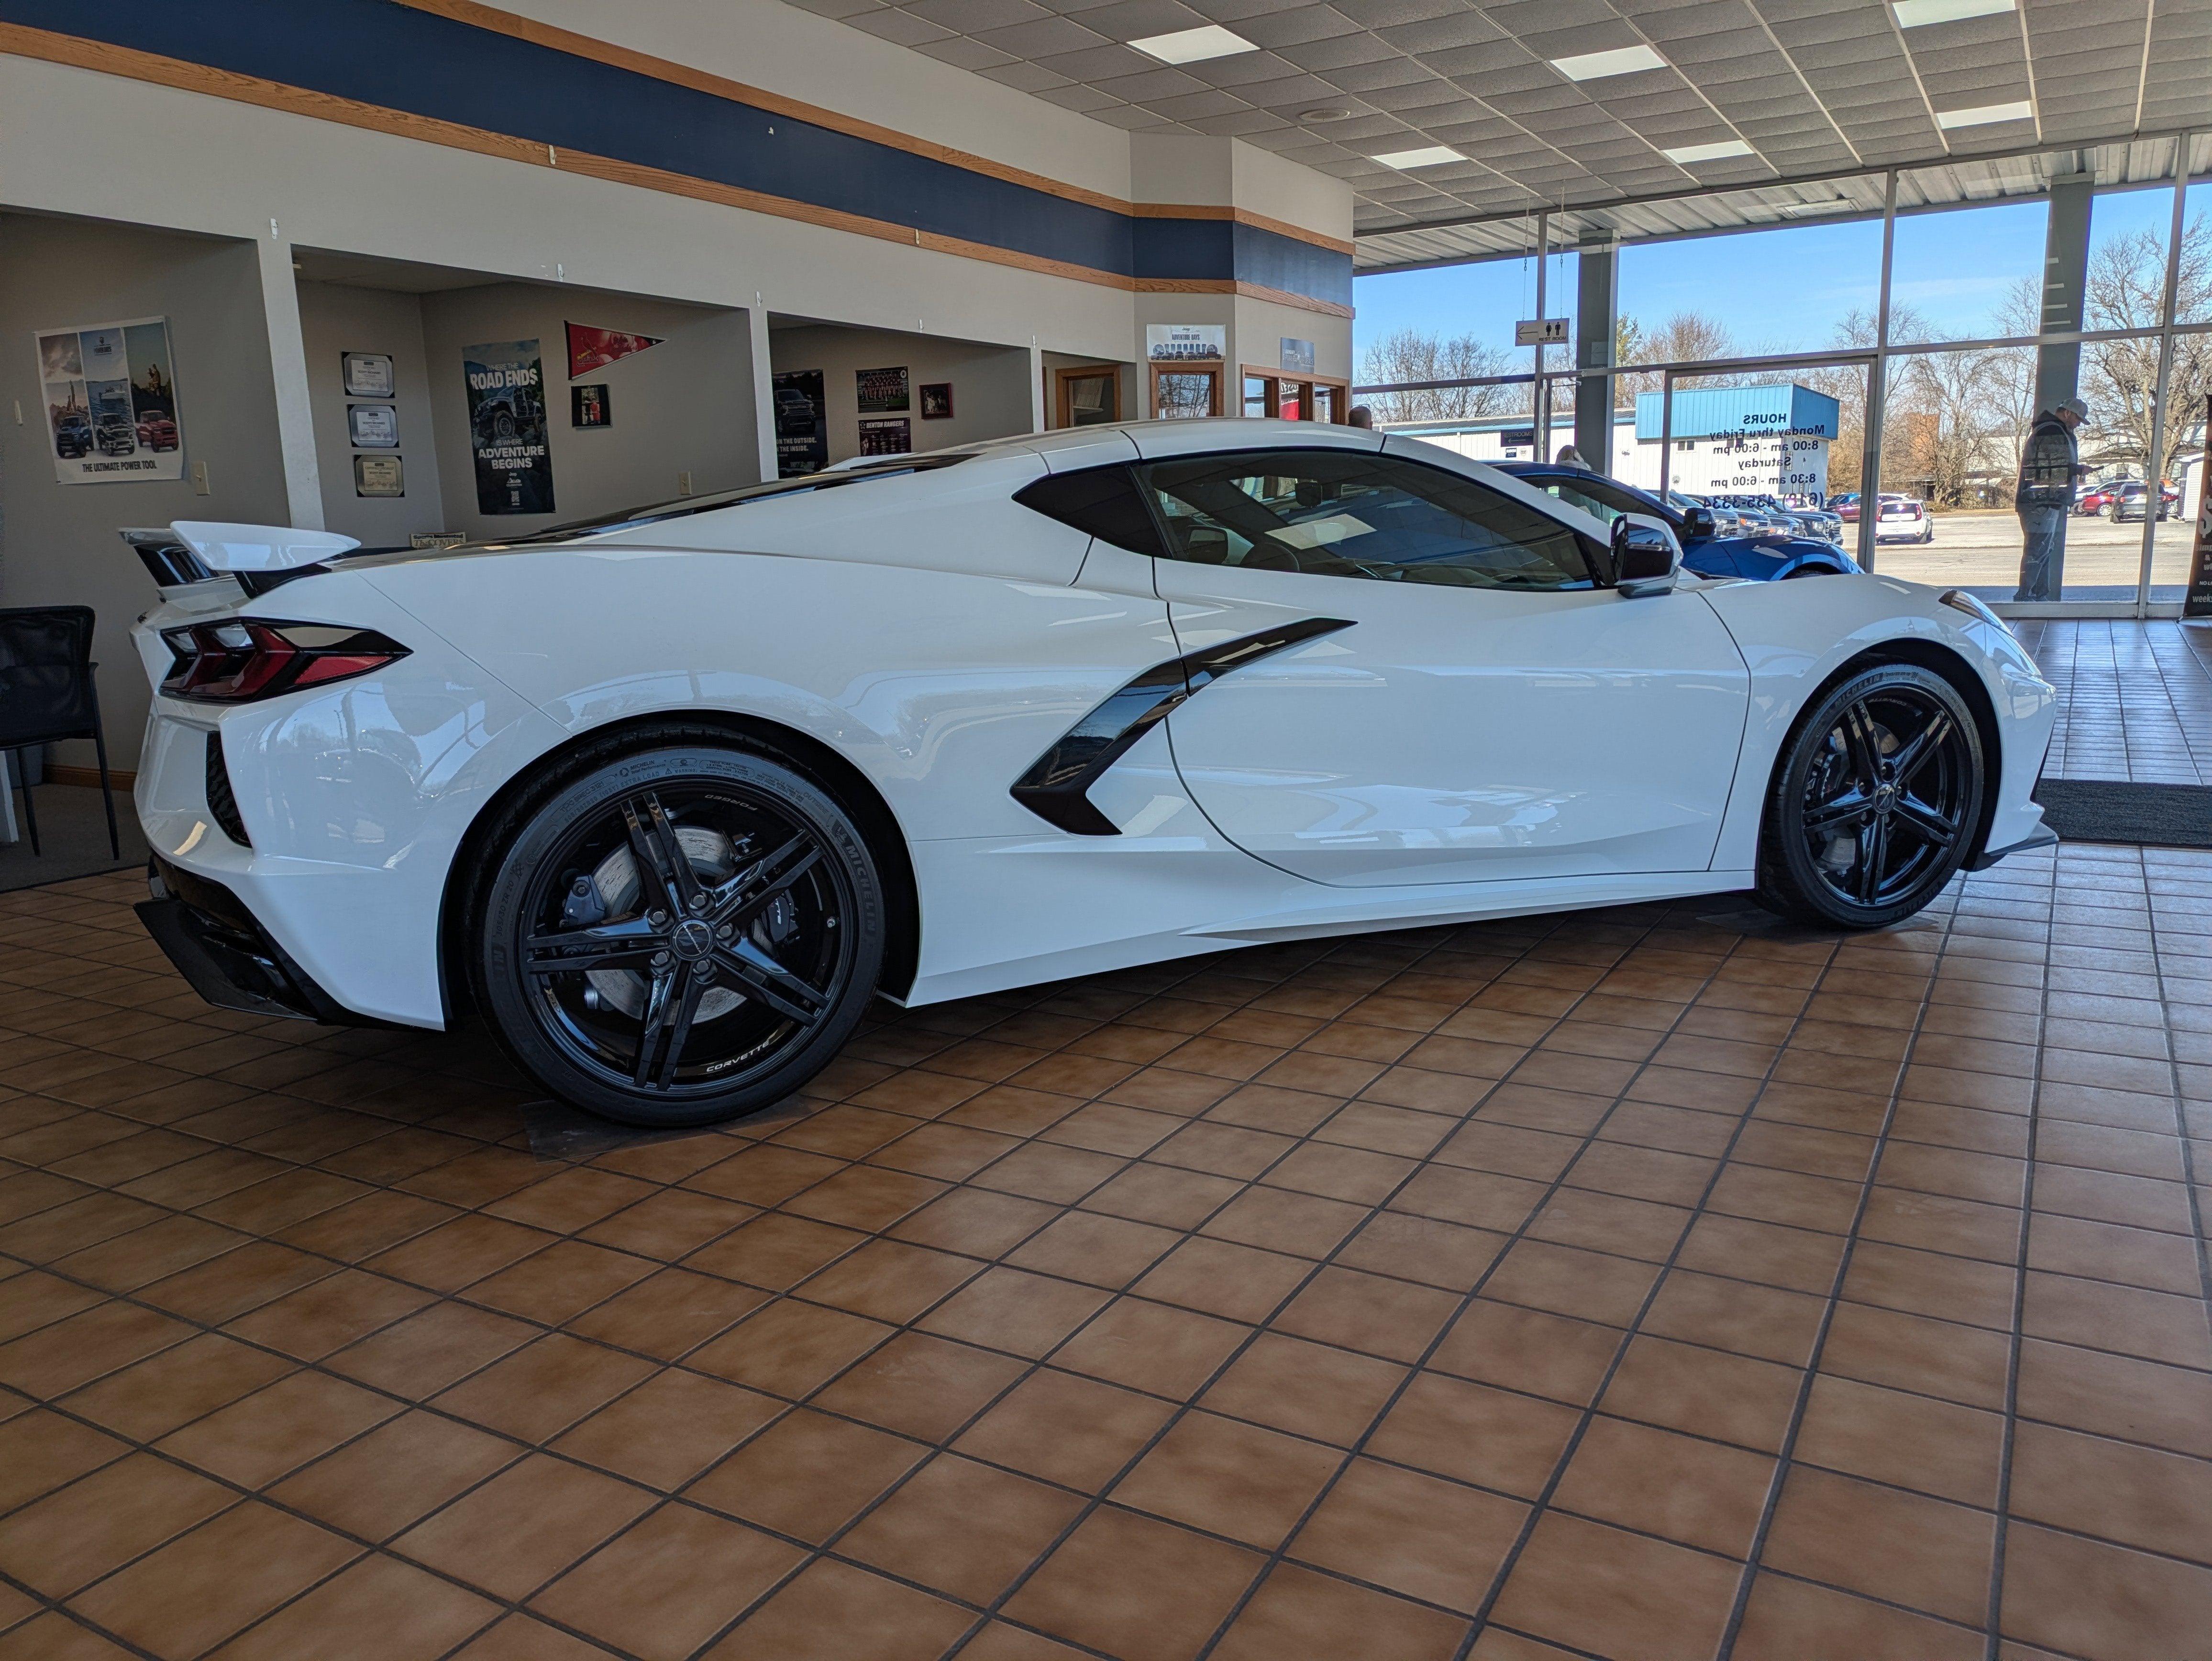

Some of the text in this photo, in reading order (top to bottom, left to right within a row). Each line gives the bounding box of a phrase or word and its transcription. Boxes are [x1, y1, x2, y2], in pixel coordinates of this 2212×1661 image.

[486, 363, 508, 371] WHERE
[470, 368, 539, 390] ROAD ENDS
[884, 420, 905, 428] RANGERS
[478, 445, 545, 459] ADVENTURE
[82, 460, 157, 472] THE ULTIMATE POWER TOOL
[491, 457, 533, 469] BEGINS
[1835, 674, 1880, 708] MICHELIN
[630, 759, 655, 771] MICHELIN
[641, 763, 666, 772] Performance
[620, 775, 641, 788] EXTRA
[642, 771, 660, 780] LOAD
[705, 794, 758, 811] FORGED
[803, 792, 830, 815] OUTSIDE
[501, 892, 509, 905] ZR
[506, 879, 514, 892] 20
[845, 844, 875, 931] MICHELIN
[706, 1040, 769, 1072] CORVETTE
